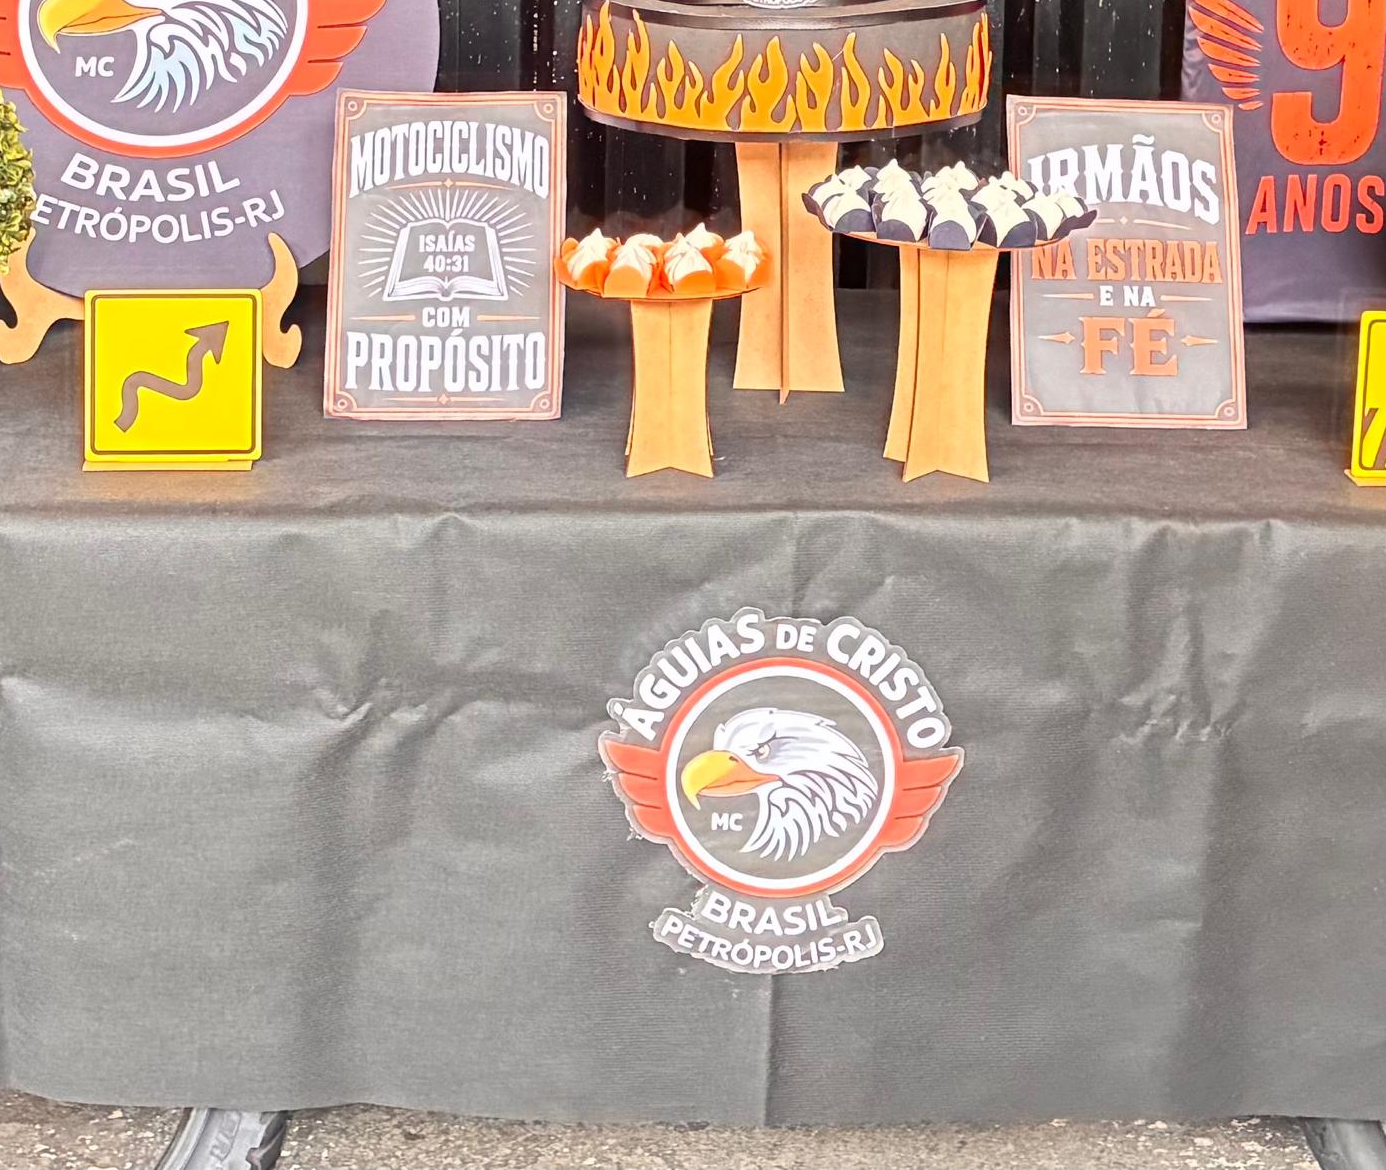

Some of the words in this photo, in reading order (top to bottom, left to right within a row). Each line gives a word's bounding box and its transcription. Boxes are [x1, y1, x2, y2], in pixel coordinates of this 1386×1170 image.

[75, 57, 114, 77] MC
[60, 152, 240, 203] BRASIL
[349, 120, 549, 199] MOTOCICLISMO
[1028, 134, 1220, 225] IRMÃOS
[29, 189, 285, 243] ETRÓPOLIS-RJ
[1245, 174, 1386, 234] ANOS
[419, 231, 476, 252] ISAÍAS
[424, 255, 469, 273] 40:31
[1032, 240, 1077, 280] NA
[1087, 238, 1223, 284] ESTRADA
[422, 307, 470, 328] COM
[1100, 285, 1114, 306] E
[1124, 286, 1157, 307] NA
[345, 328, 546, 392] PROPÓSITO
[1079, 308, 1179, 376] FÉ
[615, 614, 765, 741] ÁGUIAS
[776, 624, 816, 652] DE
[827, 624, 948, 749] CRISTO
[711, 813, 743, 832] MC
[701, 893, 842, 937] BRASIL
[660, 917, 878, 969] PETRÓPOLIS-RJ
